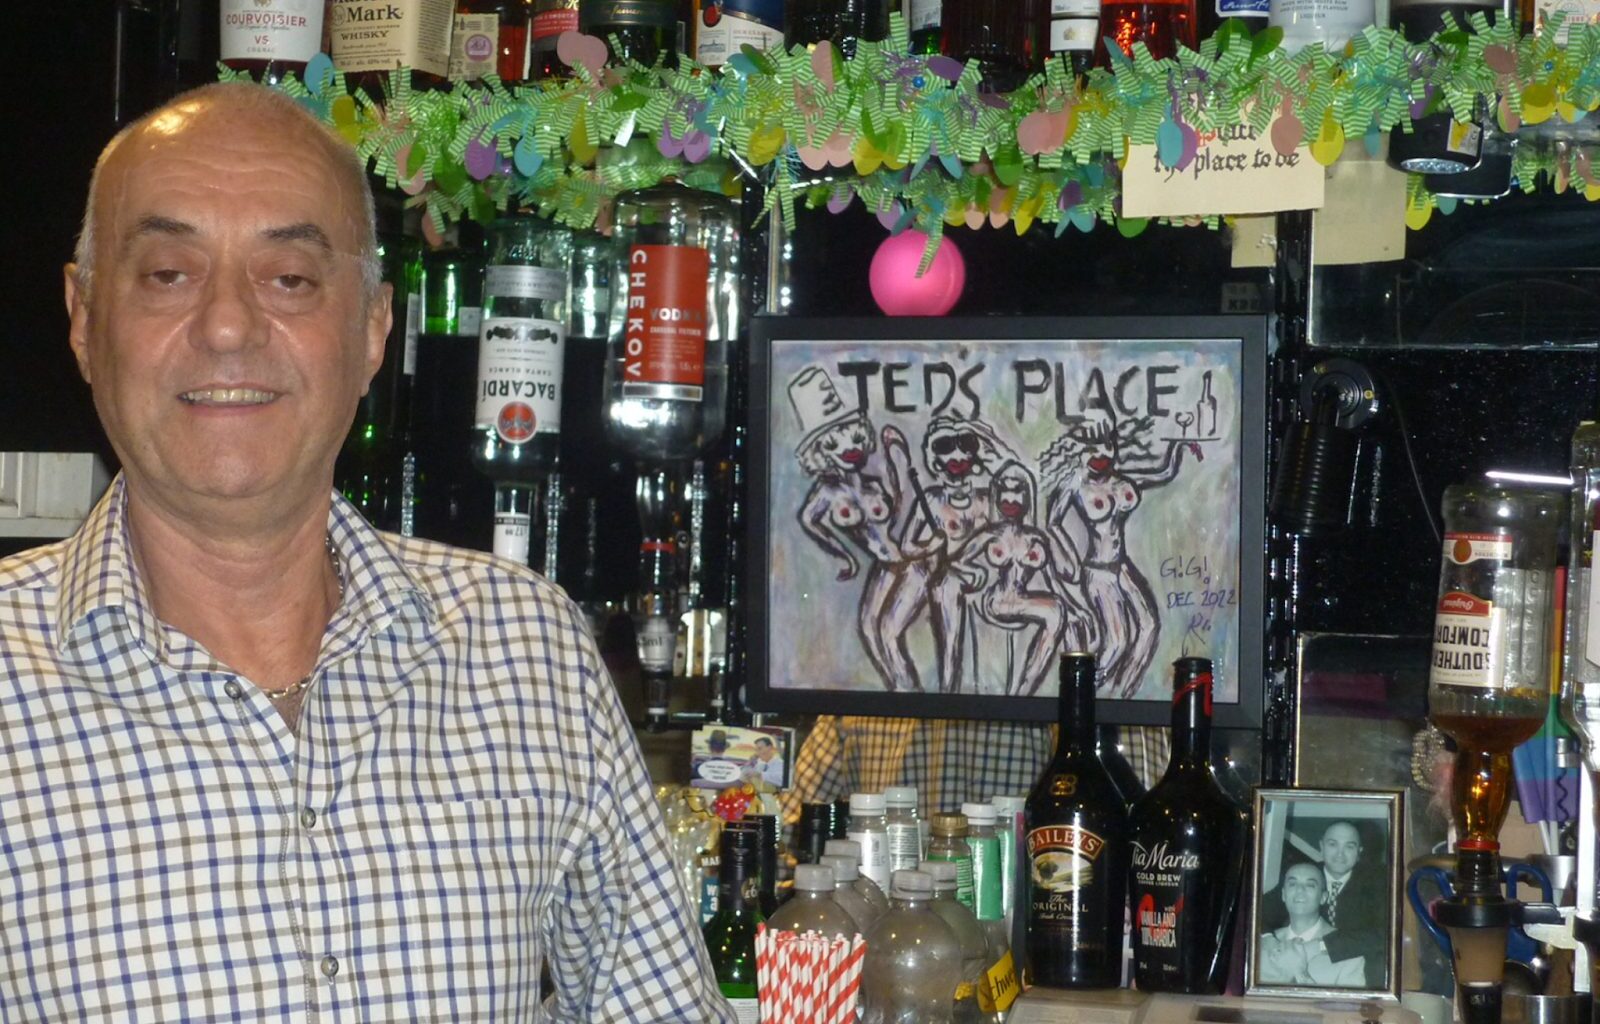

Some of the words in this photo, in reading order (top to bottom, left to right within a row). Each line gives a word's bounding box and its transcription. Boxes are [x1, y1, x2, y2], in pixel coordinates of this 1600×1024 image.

[226, 13, 308, 28] COURVOISIER
[347, 4, 403, 24] Mark
[254, 35, 270, 45] VS
[341, 30, 390, 41] WHISKY
[1194, 146, 1248, 181] place
[1251, 148, 1272, 169] to
[626, 250, 647, 377] CHEKOV
[837, 345, 986, 421] TED'S
[1011, 356, 1181, 425] PLACE
[1166, 591, 1195, 609] DEC
[1200, 589, 1237, 609] 2022
[1434, 625, 1490, 646] COMFOR
[1027, 828, 1099, 853] BAILEYS
[1143, 840, 1199, 871] Maria
[1136, 871, 1156, 882] COLD
[1157, 873, 1182, 883] BREW
